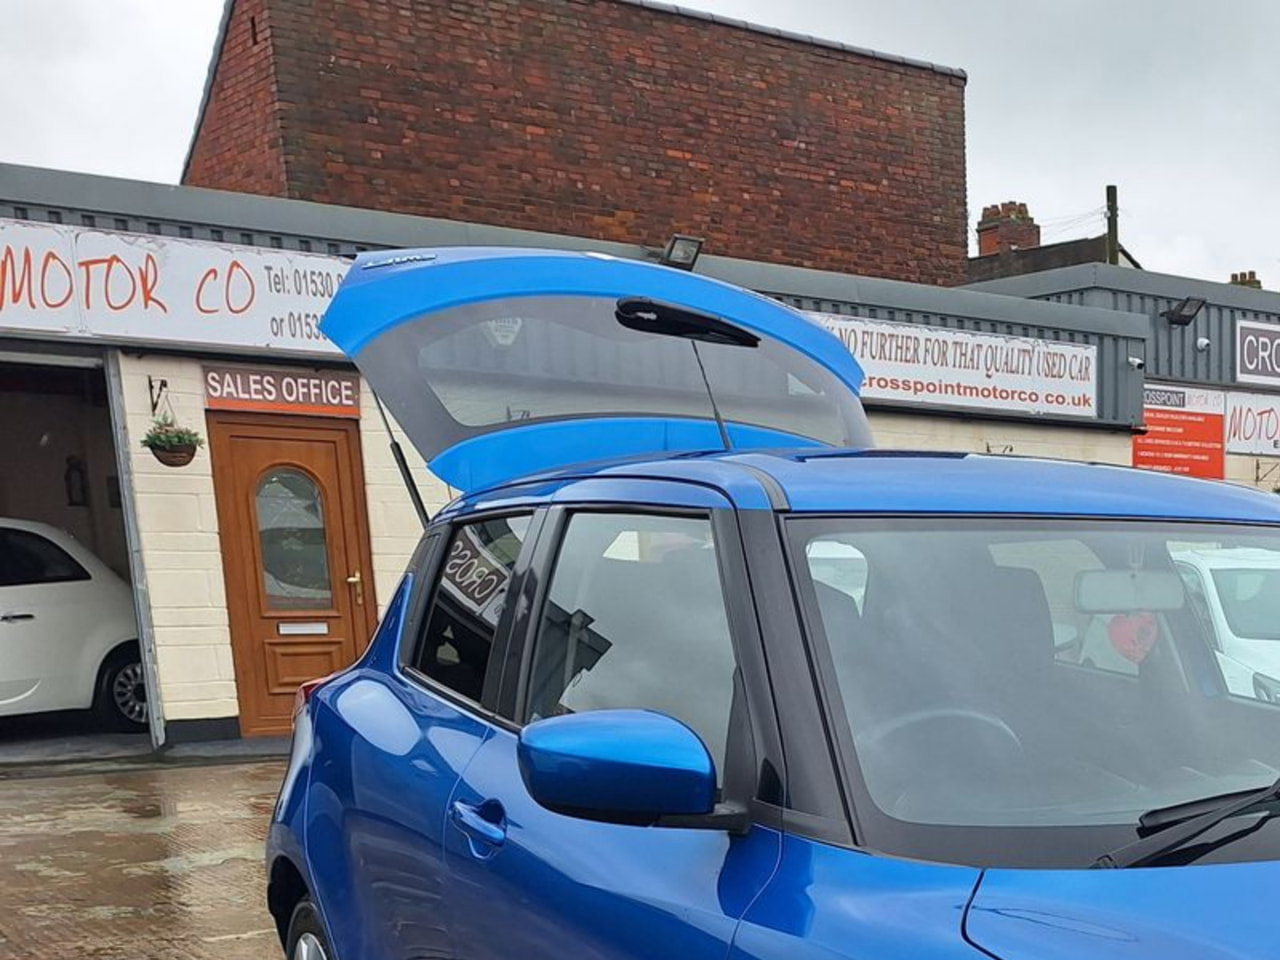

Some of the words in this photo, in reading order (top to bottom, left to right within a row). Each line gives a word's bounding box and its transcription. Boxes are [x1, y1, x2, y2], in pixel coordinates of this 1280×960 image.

[0, 244, 168, 314] MOTOR
[195, 259, 256, 314] CO
[264, 265, 291, 294] Tel:
[294, 269, 334, 298] 01530
[270, 316, 284, 337] or
[861, 330, 921, 364] FURTHER
[922, 336, 949, 367] FOR
[952, 341, 982, 371] THAT
[984, 344, 1034, 379] QUALITY
[1036, 350, 1067, 379] USED
[1069, 354, 1091, 381] CAR
[207, 371, 277, 400] SALES
[281, 376, 354, 405] OFFICE
